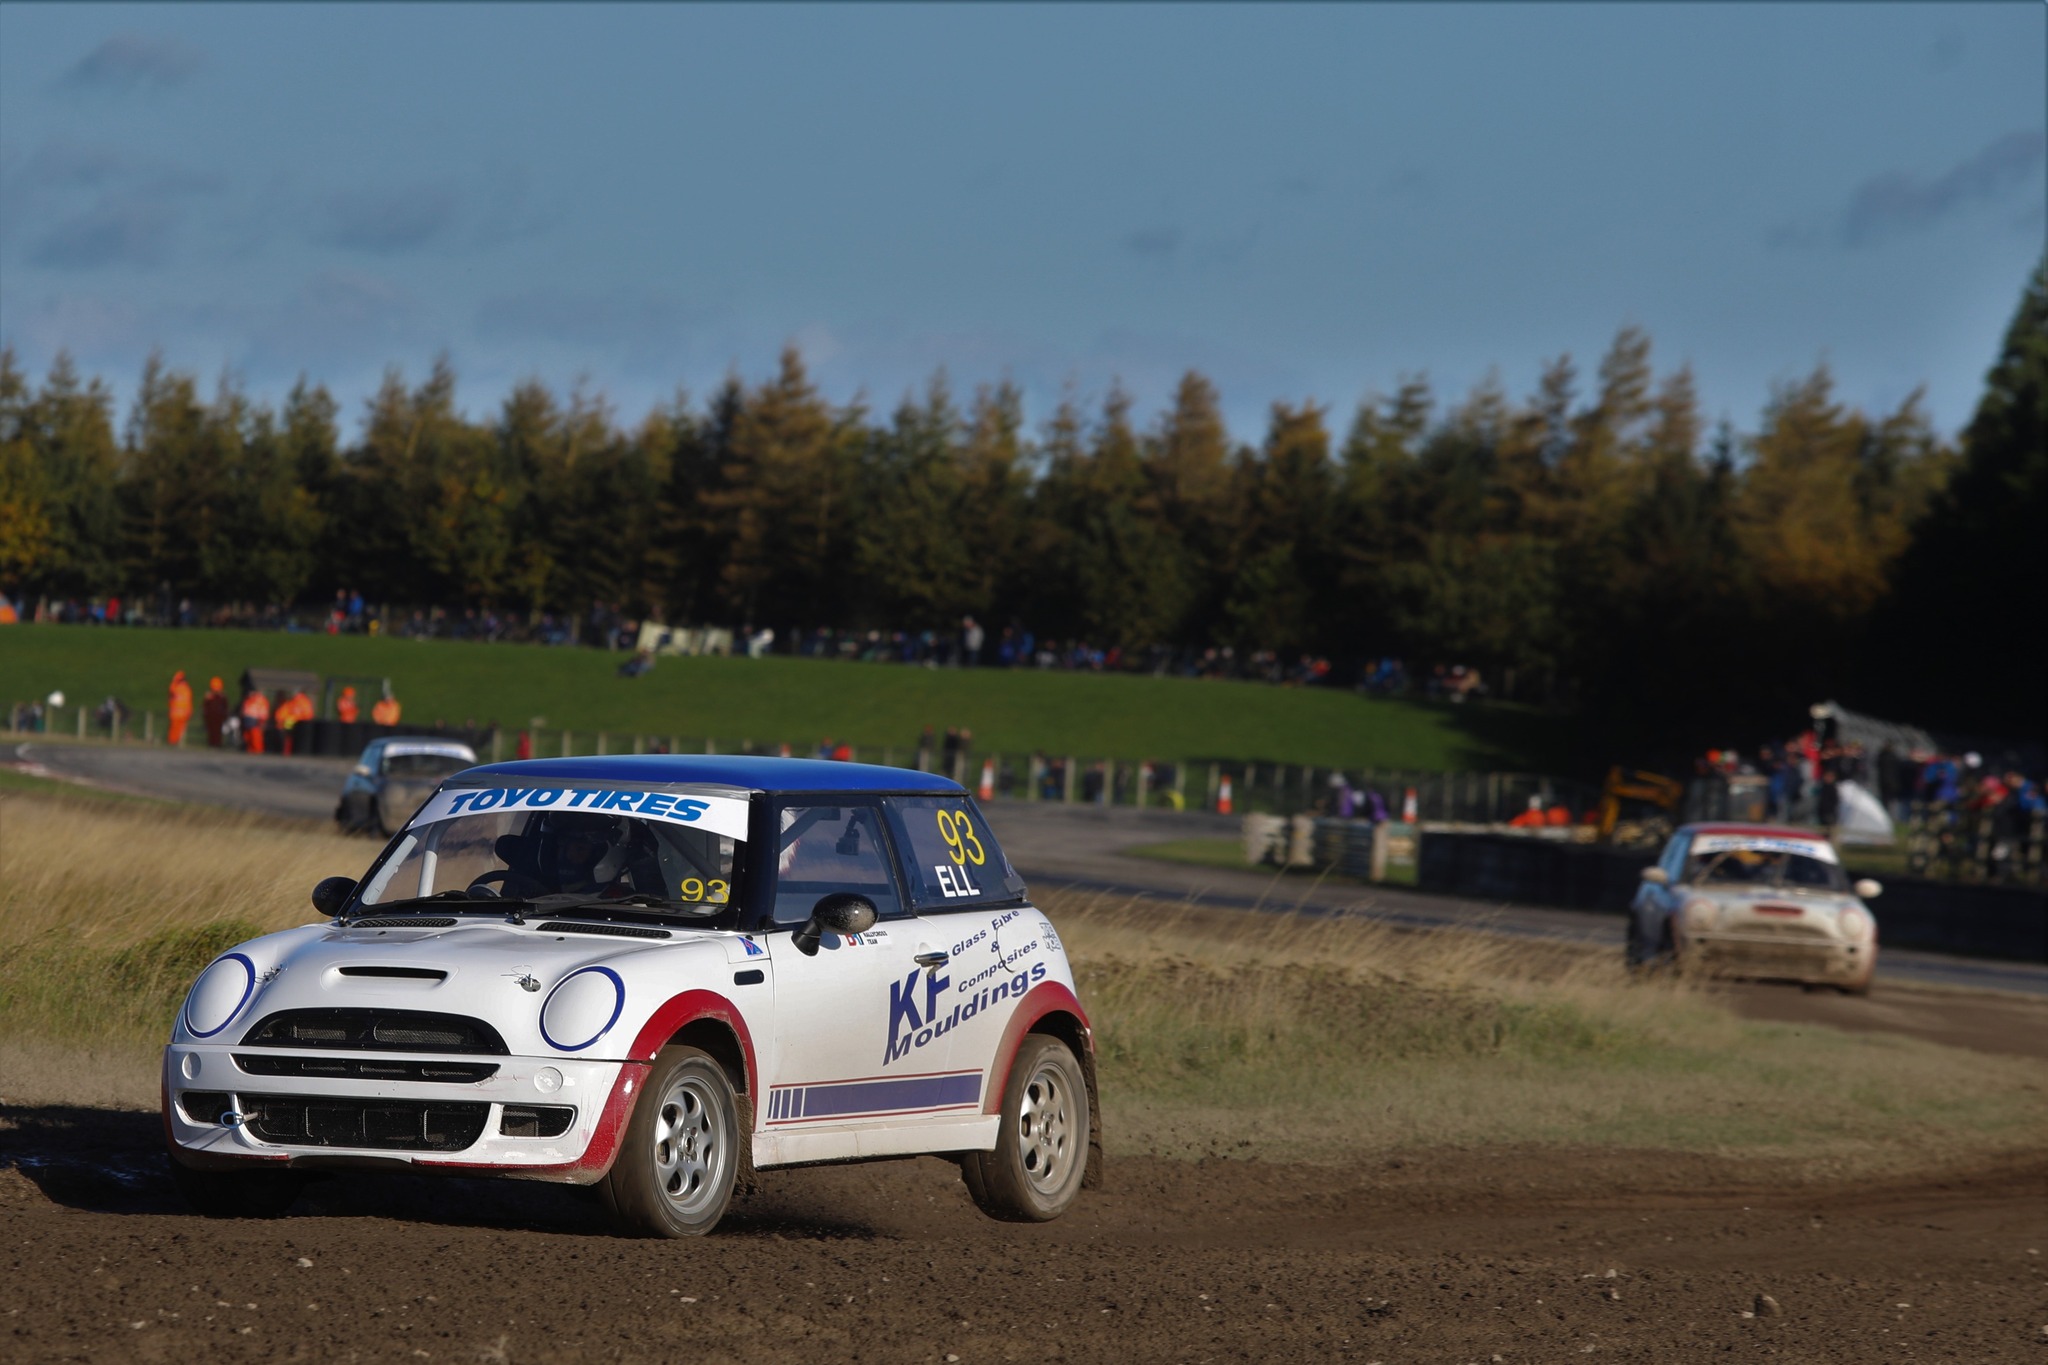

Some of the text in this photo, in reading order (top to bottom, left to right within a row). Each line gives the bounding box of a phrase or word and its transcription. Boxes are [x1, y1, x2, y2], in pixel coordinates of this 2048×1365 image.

[447, 788, 710, 822] TOYO TIRES
[937, 809, 985, 866] 93
[680, 877, 729, 904] 93
[934, 865, 980, 898] ELL
[952, 910, 1020, 957] Glass Fibre
[991, 940, 1000, 953] &
[958, 939, 1038, 993] Composites
[883, 961, 1047, 1067] Mouldings
[888, 951, 950, 1040] KF
